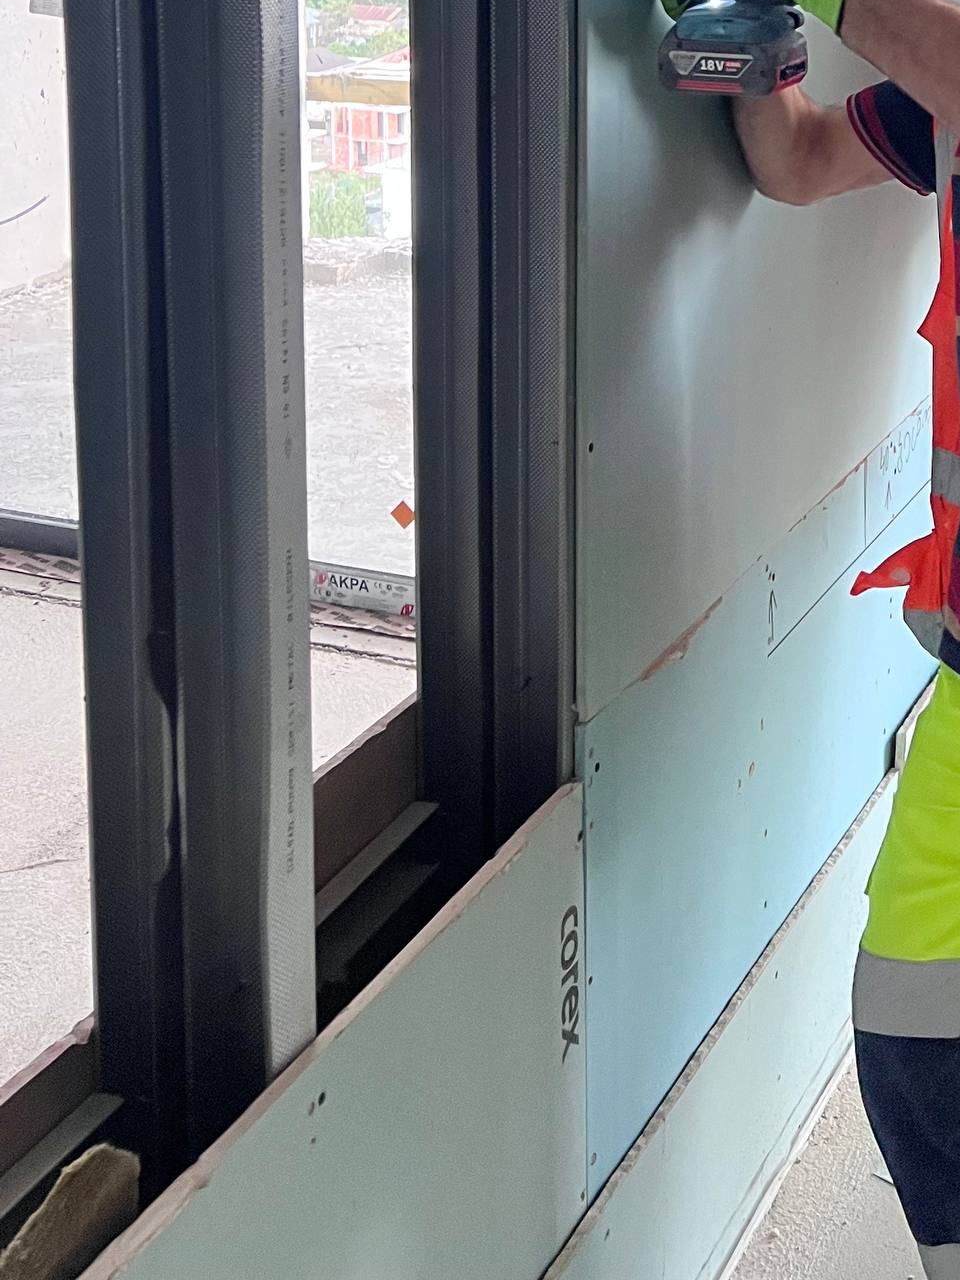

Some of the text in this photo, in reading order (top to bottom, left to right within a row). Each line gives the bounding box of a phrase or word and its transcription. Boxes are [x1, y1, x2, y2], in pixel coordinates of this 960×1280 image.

[700, 59, 725, 72] 18V
[328, 574, 370, 593] AKPA
[560, 904, 580, 1066] corex
